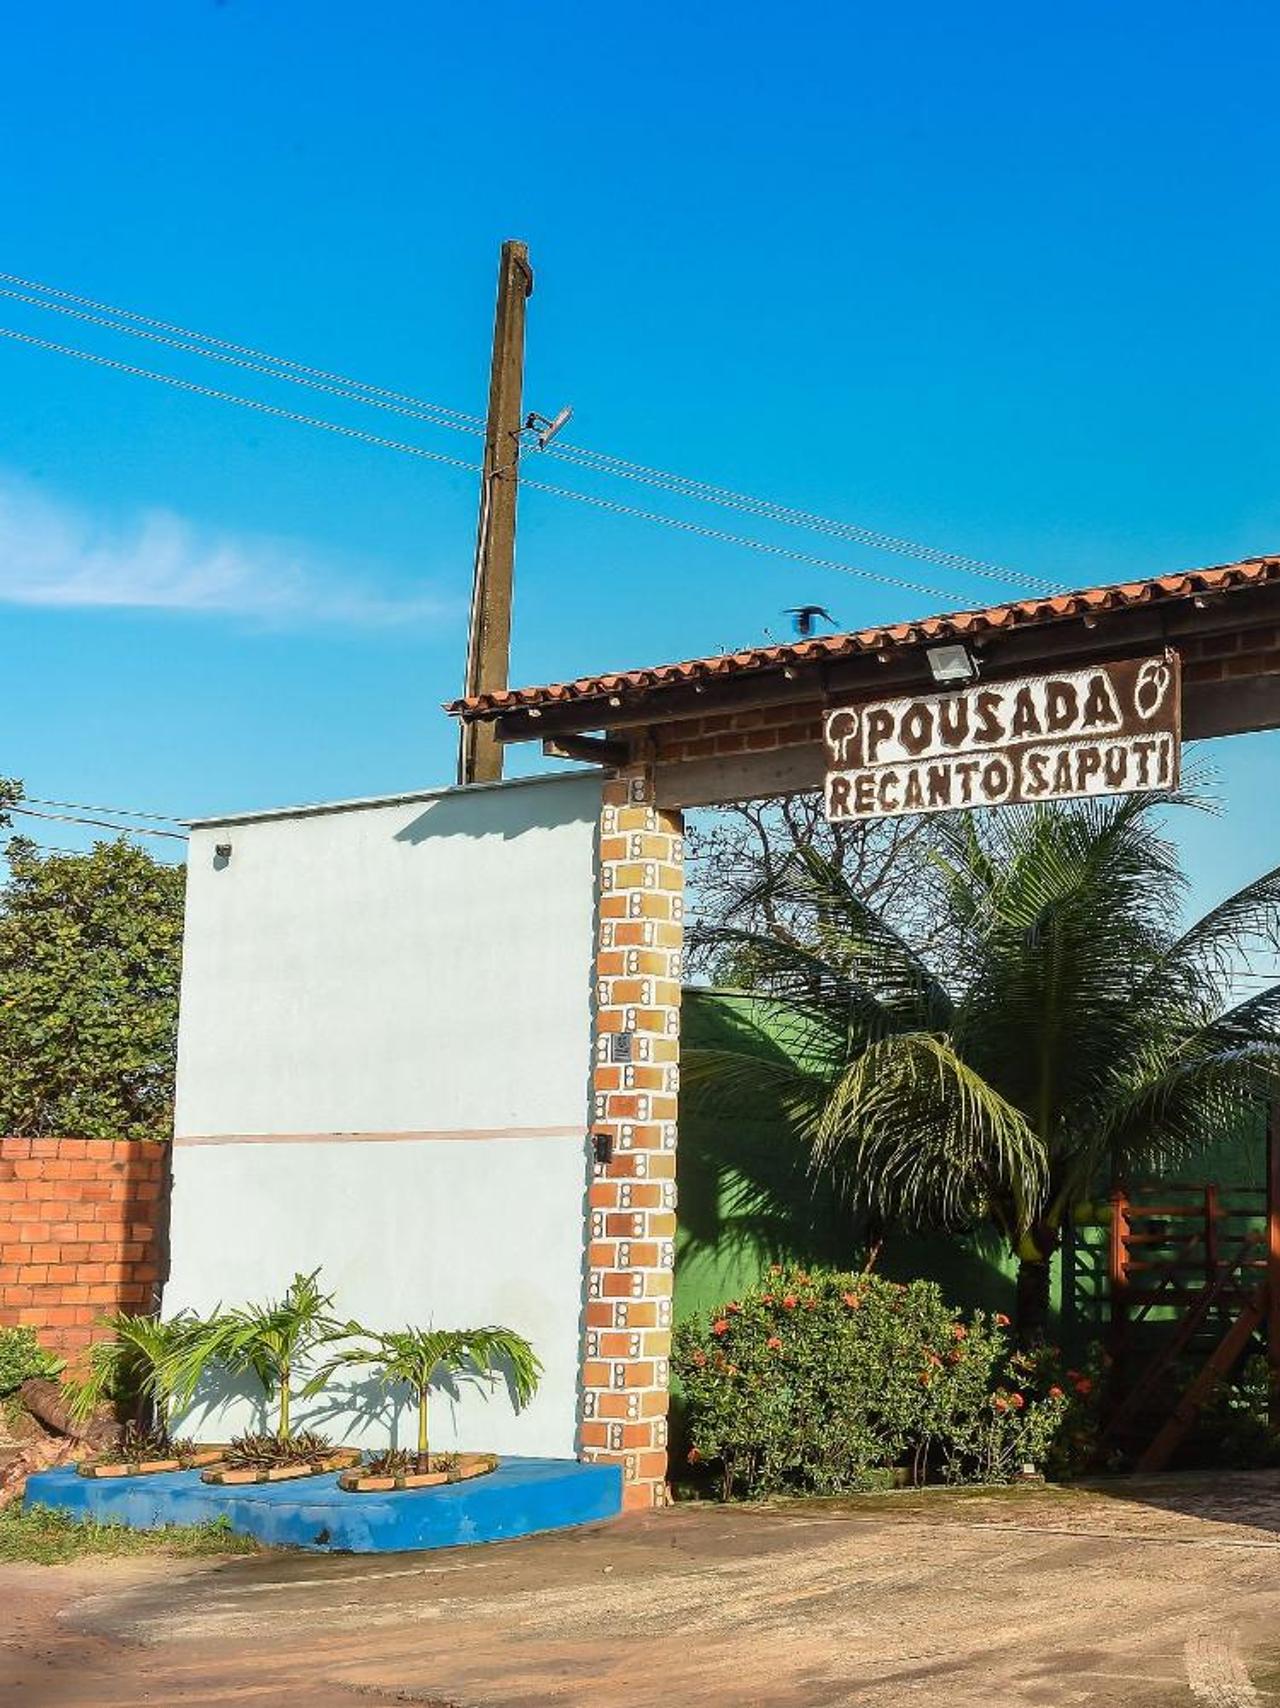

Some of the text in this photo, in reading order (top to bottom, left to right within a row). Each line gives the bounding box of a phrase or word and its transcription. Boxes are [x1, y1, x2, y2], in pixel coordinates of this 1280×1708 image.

[867, 674, 1118, 762] POUSADA
[830, 739, 1170, 813] RECANTO SAPUTI
